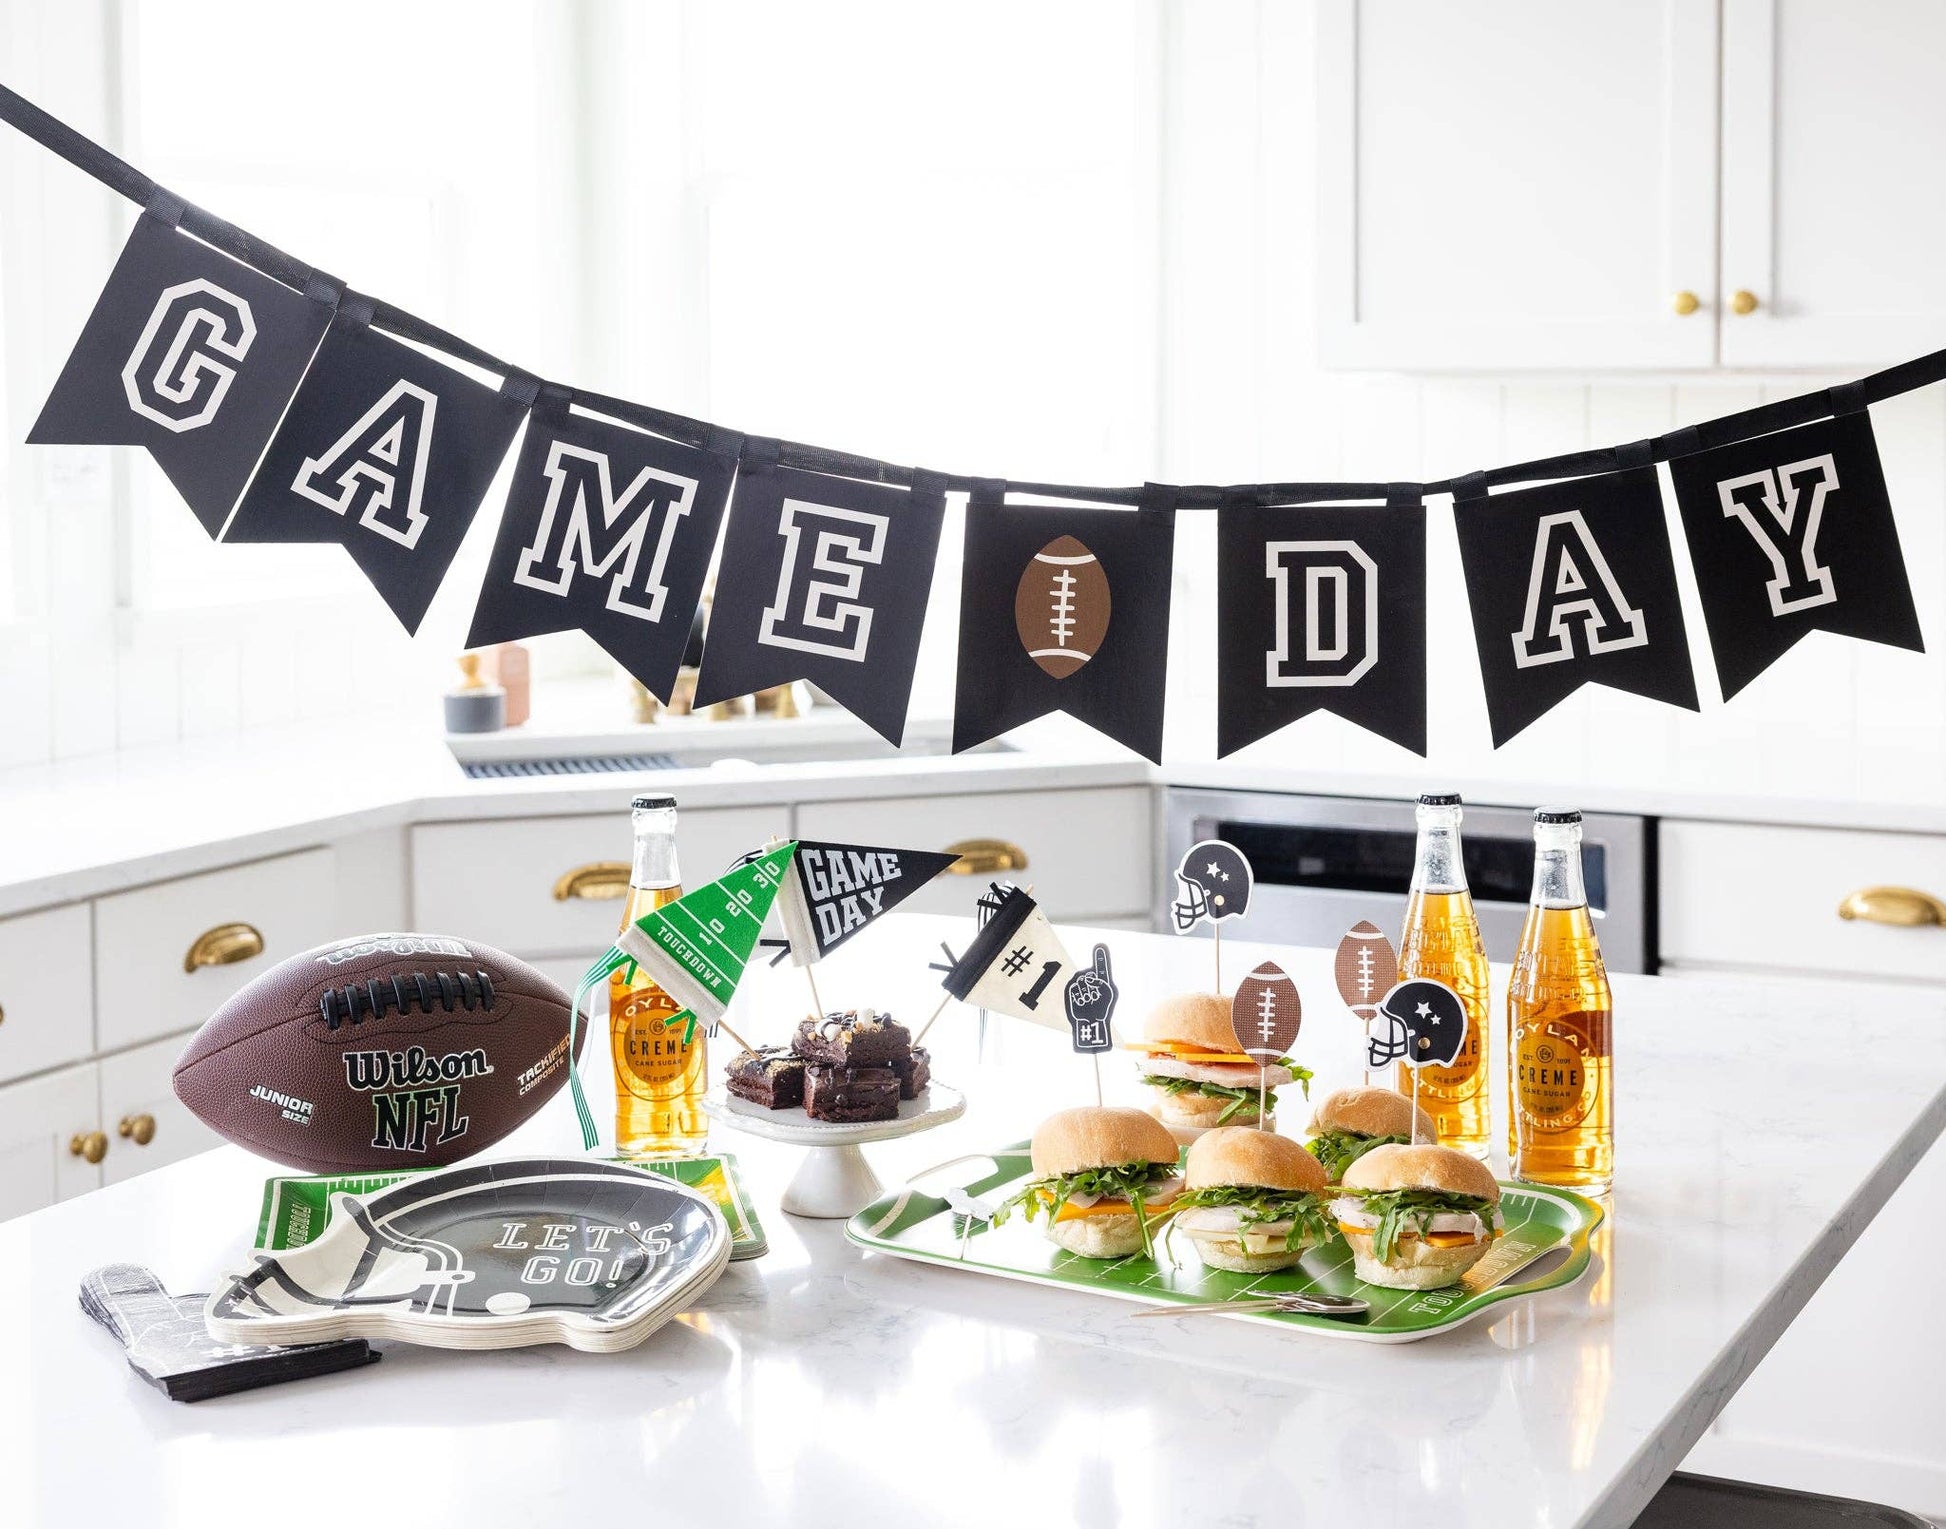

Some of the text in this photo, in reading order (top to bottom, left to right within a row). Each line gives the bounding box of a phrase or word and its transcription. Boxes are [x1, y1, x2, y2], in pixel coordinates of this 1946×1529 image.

[121, 278, 1840, 687] GAME DAY
[752, 861, 780, 889] 30
[801, 849, 902, 901] GAME
[725, 889, 753, 917] 20
[815, 886, 884, 947] DAY
[699, 918, 725, 946] 10
[657, 926, 722, 988] TOUCHDOWN
[1000, 946, 1062, 1010] #1
[630, 1040, 688, 1056] CREME
[1080, 1022, 1104, 1044] #1
[343, 1045, 489, 1091] Wilson
[519, 1056, 564, 1096] COMPOSITE
[1519, 1064, 1577, 1086] CREME
[249, 1084, 314, 1115] JUNIOR
[1523, 1086, 1541, 1096] CANE
[281, 1110, 310, 1125] SIZE
[372, 1084, 469, 1153] NFL
[493, 1221, 674, 1256] LET'S
[520, 1255, 624, 1288] GO!
